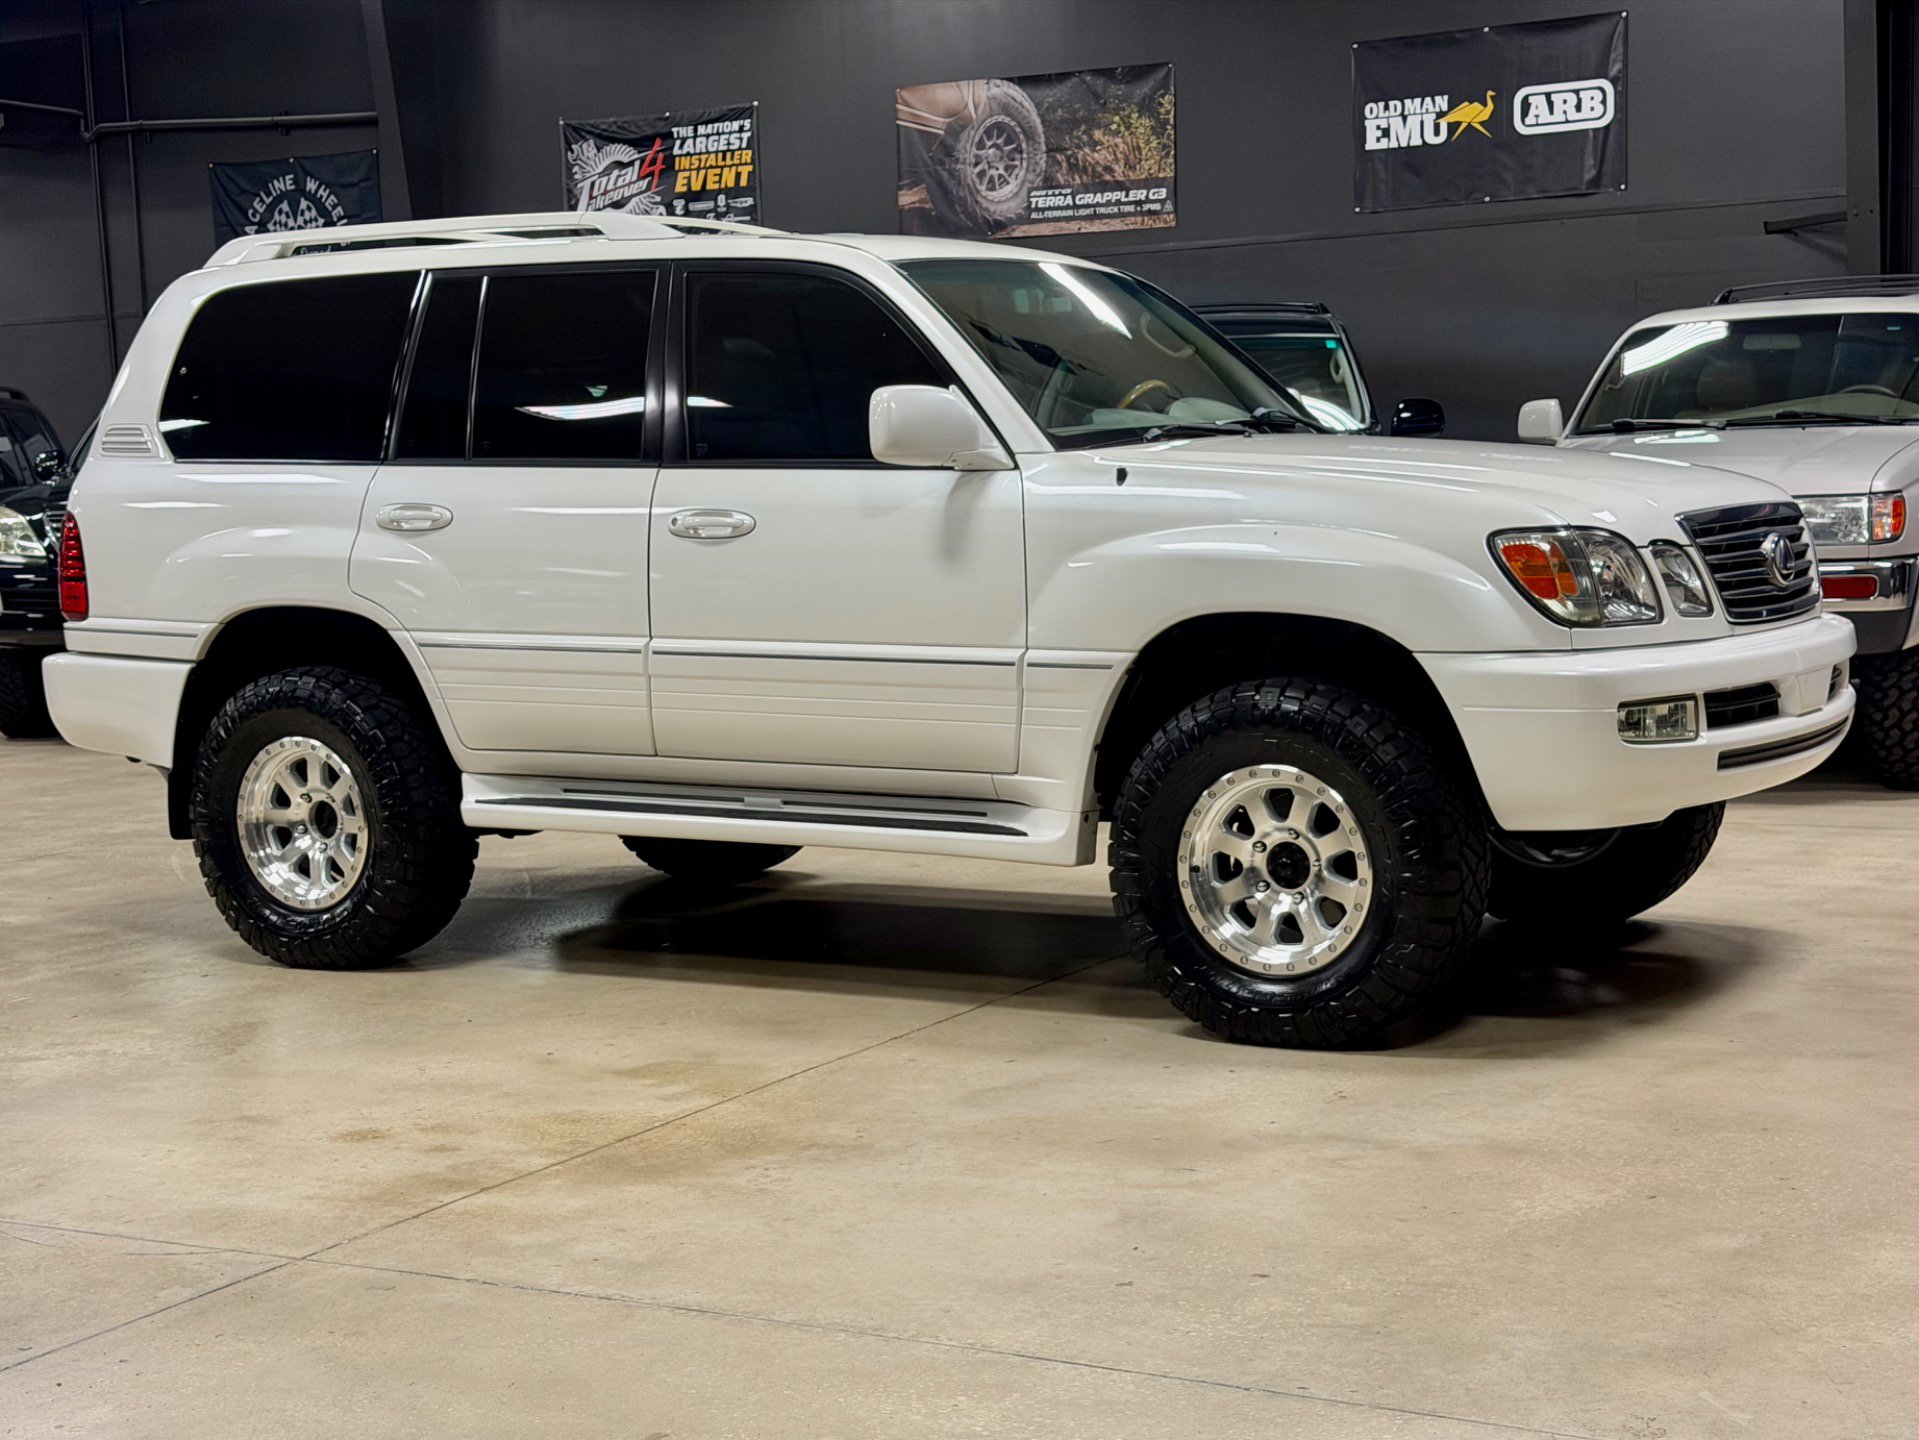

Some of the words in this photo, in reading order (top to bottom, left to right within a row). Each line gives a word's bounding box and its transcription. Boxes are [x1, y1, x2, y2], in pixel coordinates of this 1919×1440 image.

[1364, 101, 1401, 119] OLD
[1404, 95, 1448, 113] MAN
[1523, 88, 1605, 126] ARB
[671, 125, 694, 139] THE
[697, 119, 752, 134] NATION'S
[1364, 112, 1449, 150] EMU
[672, 131, 752, 155] LARGEST
[674, 150, 752, 171] INSTALLER
[577, 159, 641, 211] Total
[639, 137, 667, 192] 4
[674, 165, 754, 193] EVENT
[244, 174, 296, 236] ACELINE
[1029, 194, 1074, 209] TERRA
[1075, 189, 1148, 206] GRAPPLER
[1148, 187, 1167, 200] G3
[1074, 207, 1094, 217] LIGHT
[1095, 205, 1119, 215] TRUCK
[1119, 204, 1136, 213] TIRE
